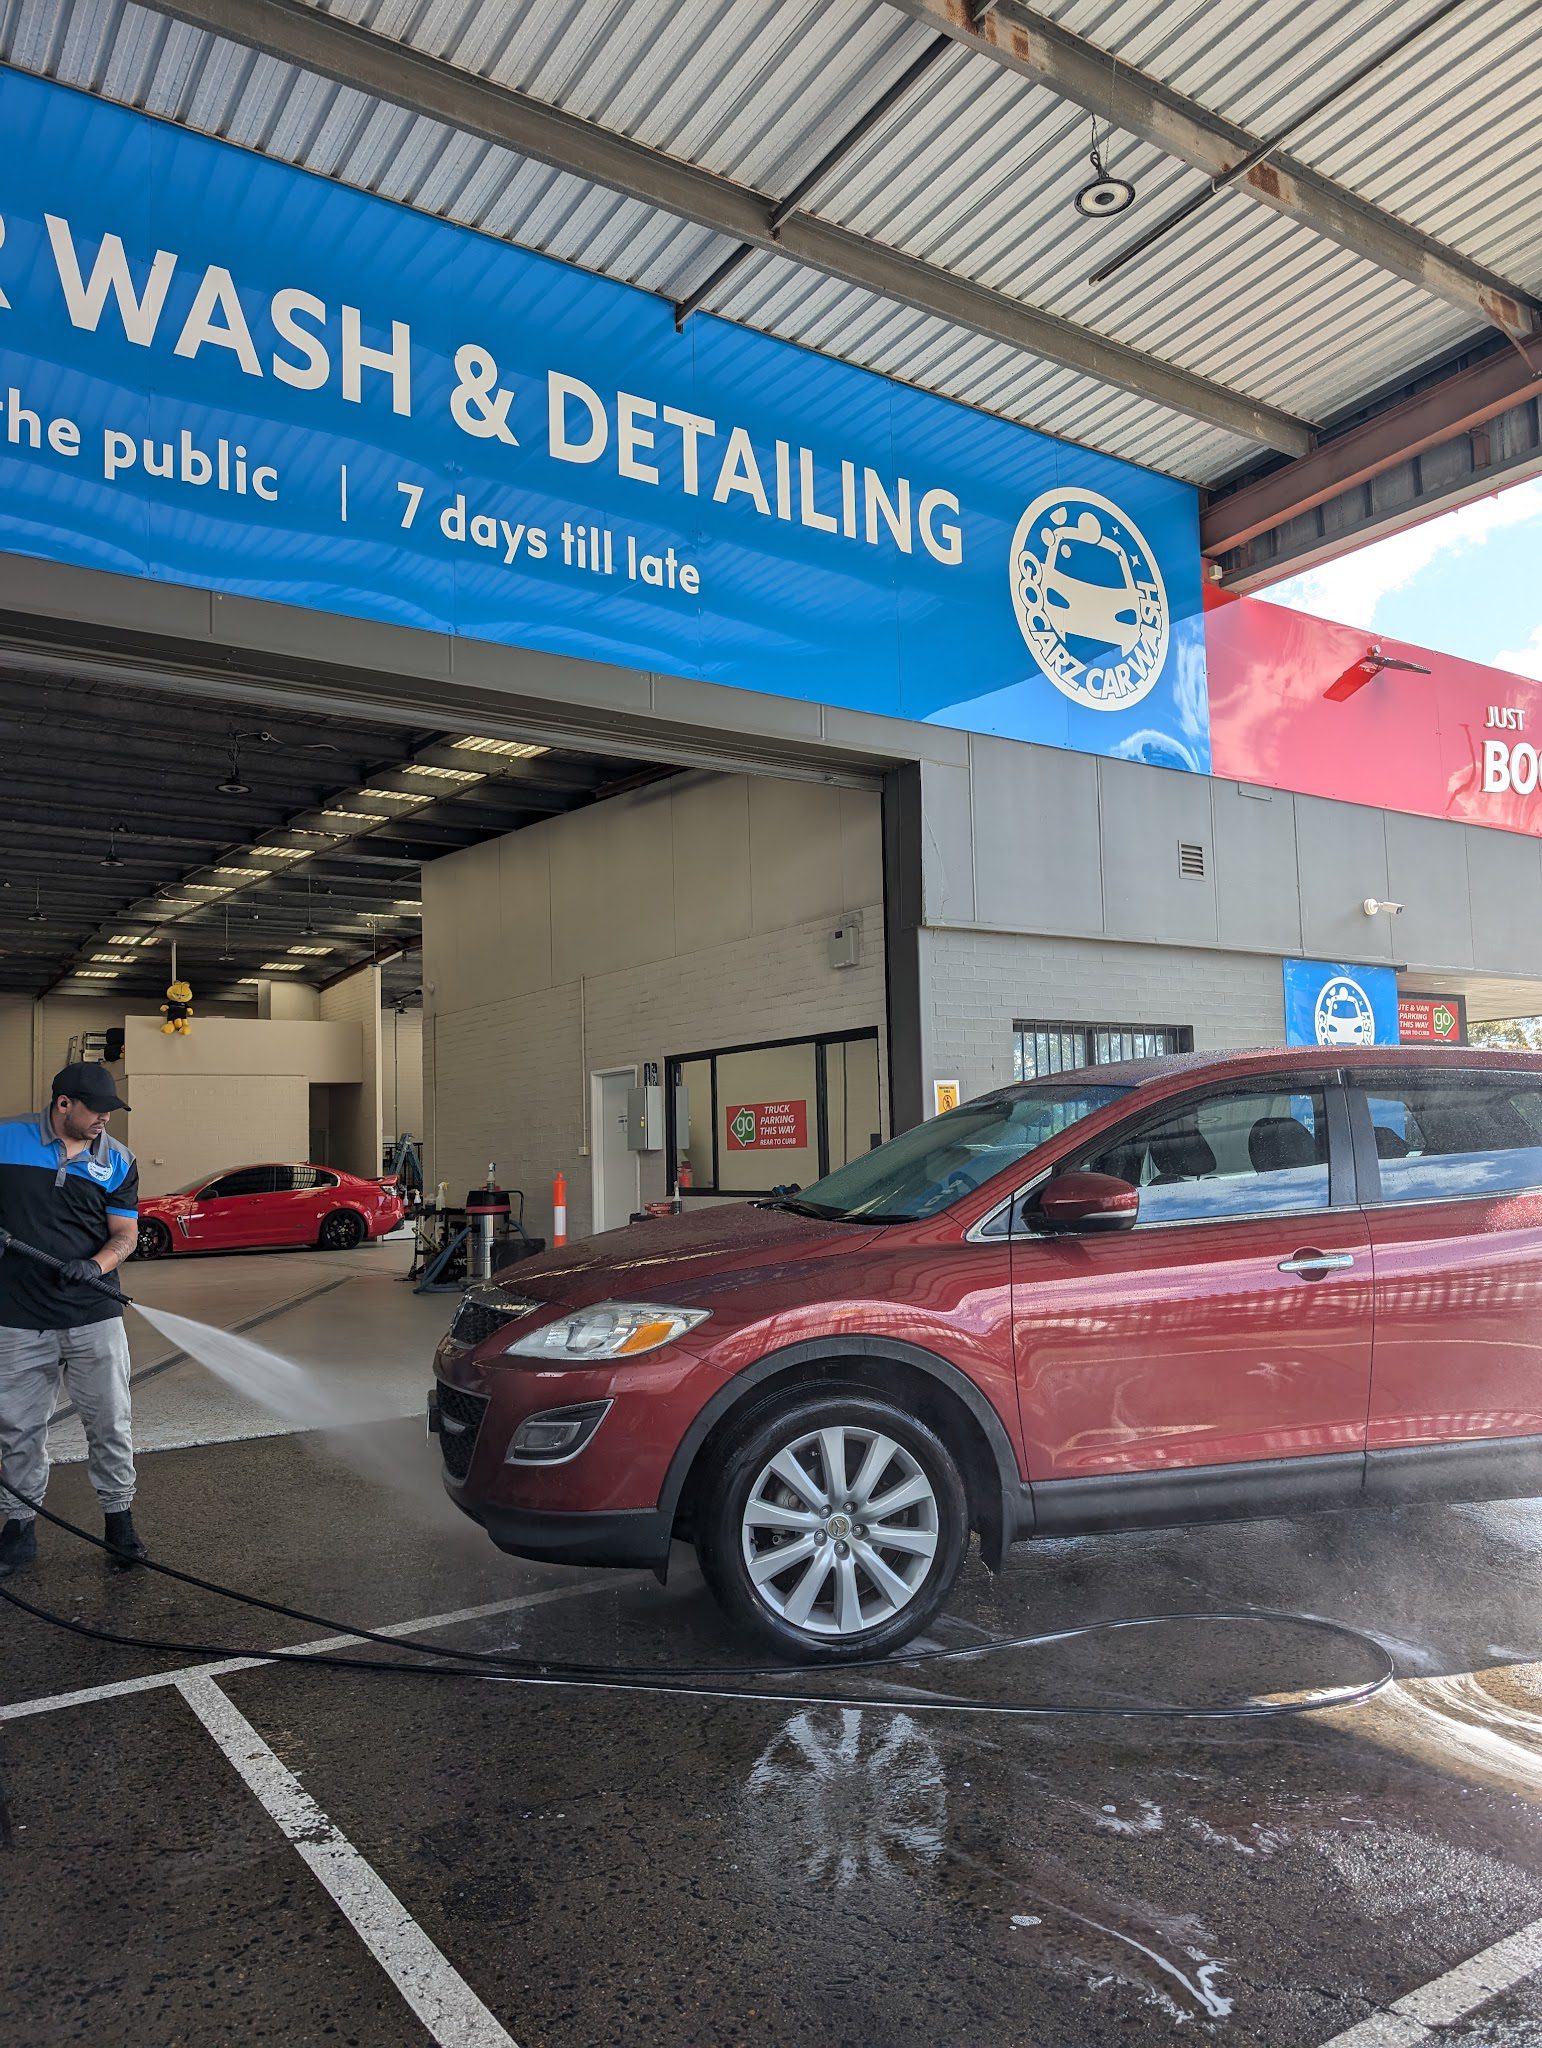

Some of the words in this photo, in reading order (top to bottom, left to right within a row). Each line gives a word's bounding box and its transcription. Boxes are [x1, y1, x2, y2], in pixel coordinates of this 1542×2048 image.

[44, 213, 411, 417] WASH
[450, 344, 520, 447] &
[548, 370, 962, 565] DETAILING
[0, 387, 80, 456] he
[104, 429, 278, 501] public
[397, 482, 424, 529] 7
[440, 494, 548, 564] days
[561, 522, 613, 575] till
[627, 536, 700, 595] late
[1085, 663, 1138, 700] CAR
[1127, 580, 1163, 681] WASH
[1485, 705, 1526, 731] JUST
[1481, 740, 1542, 796] BO
[1399, 1012, 1428, 1020] PARKING
[1415, 1021, 1429, 1029] WAY
[1435, 1012, 1451, 1030] go
[764, 1104, 790, 1115] TRUCK
[736, 1116, 754, 1138] go
[760, 1115, 795, 1125] PARKING
[760, 1126, 777, 1136] THIS
[778, 1125, 796, 1134] WAY
[760, 1138, 774, 1146] REAR
[782, 1137, 797, 1145] CURB
